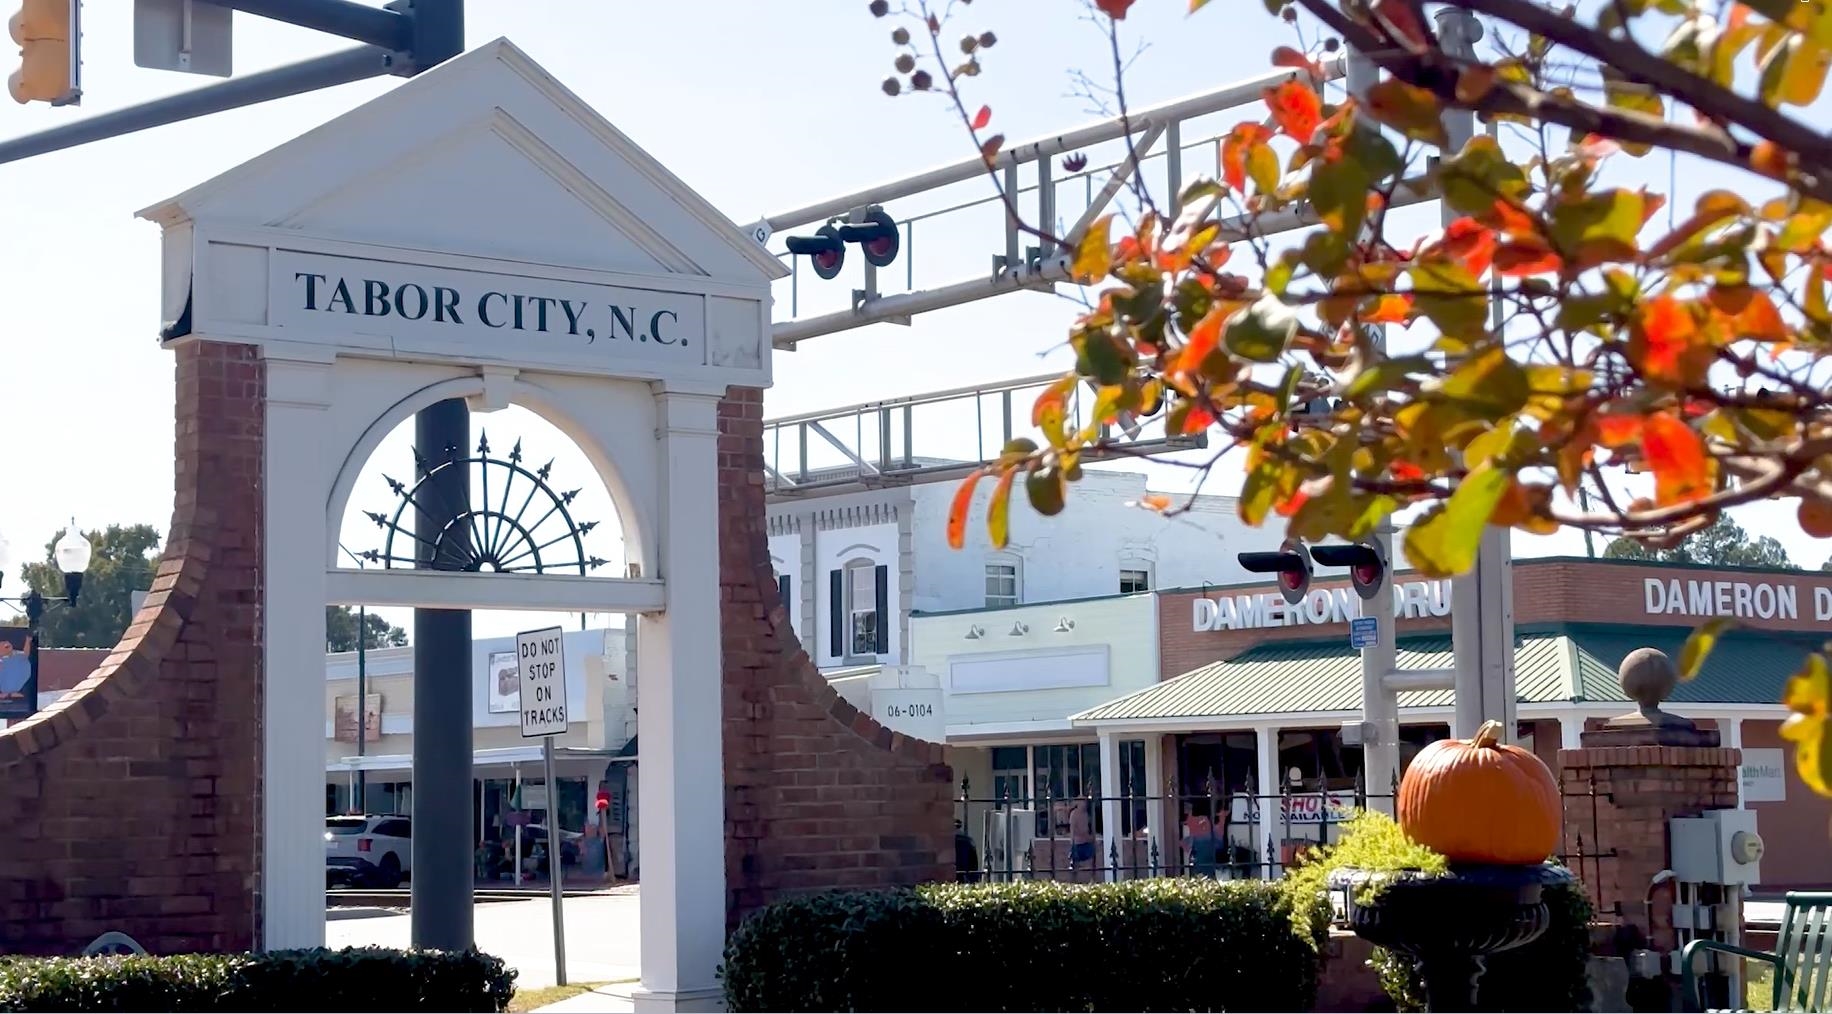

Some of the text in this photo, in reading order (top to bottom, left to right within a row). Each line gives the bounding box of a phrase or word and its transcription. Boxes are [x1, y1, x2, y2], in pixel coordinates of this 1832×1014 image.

[295, 272, 689, 347] TABOR CITY, N.C.
[1643, 578, 1798, 620] DAMERON
[1193, 587, 1359, 632] DAMERON
[521, 642, 537, 659] DO
[541, 637, 560, 656] NOT
[529, 662, 556, 681] STOP
[536, 685, 552, 702] ON
[524, 706, 565, 726] TRACKS
[887, 703, 933, 718] 06-0104
[1280, 793, 1341, 812] SHOS
